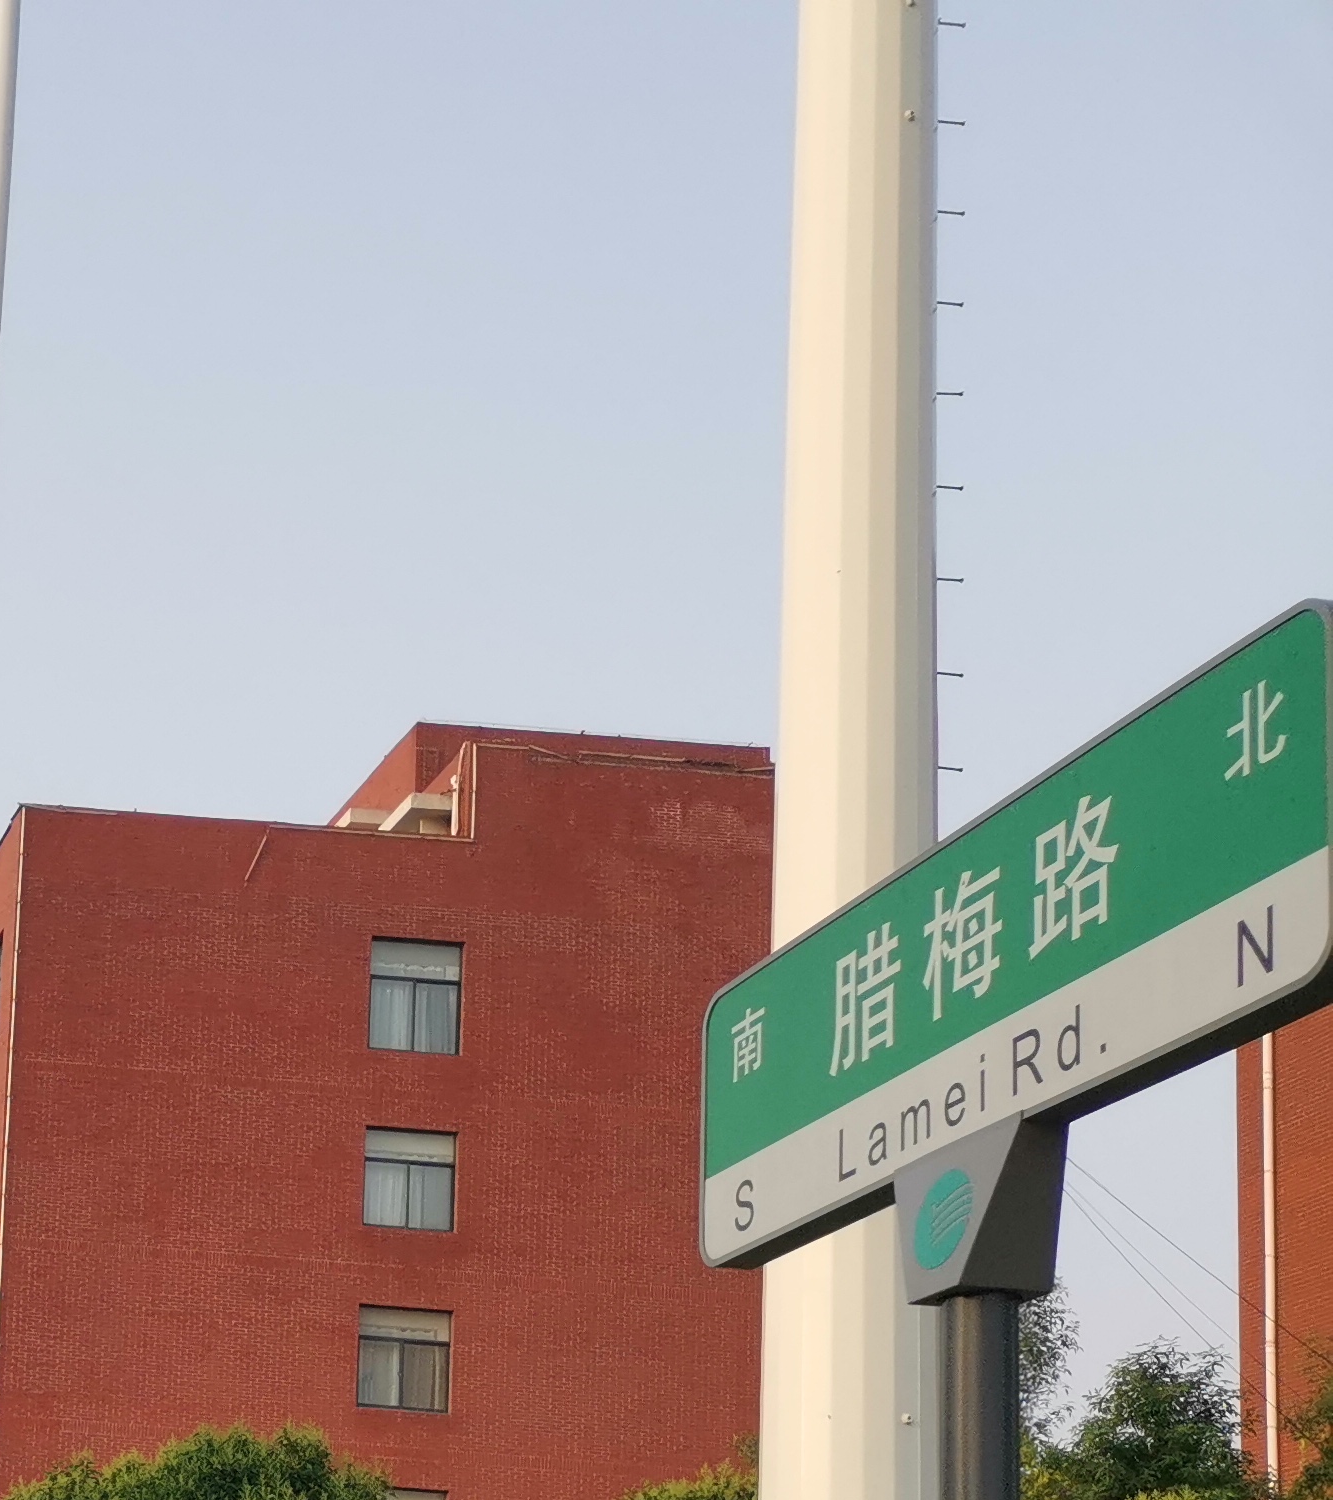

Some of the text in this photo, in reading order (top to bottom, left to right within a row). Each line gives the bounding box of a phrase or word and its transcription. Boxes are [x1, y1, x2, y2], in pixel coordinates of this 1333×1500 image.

[1225, 680, 1287, 781] 北
[830, 795, 1119, 1076] 腊梅路
[1238, 905, 1274, 986] N
[731, 1008, 765, 1082] 南
[839, 1005, 1107, 1181] Lamei Rd.
[735, 1180, 755, 1231] S
